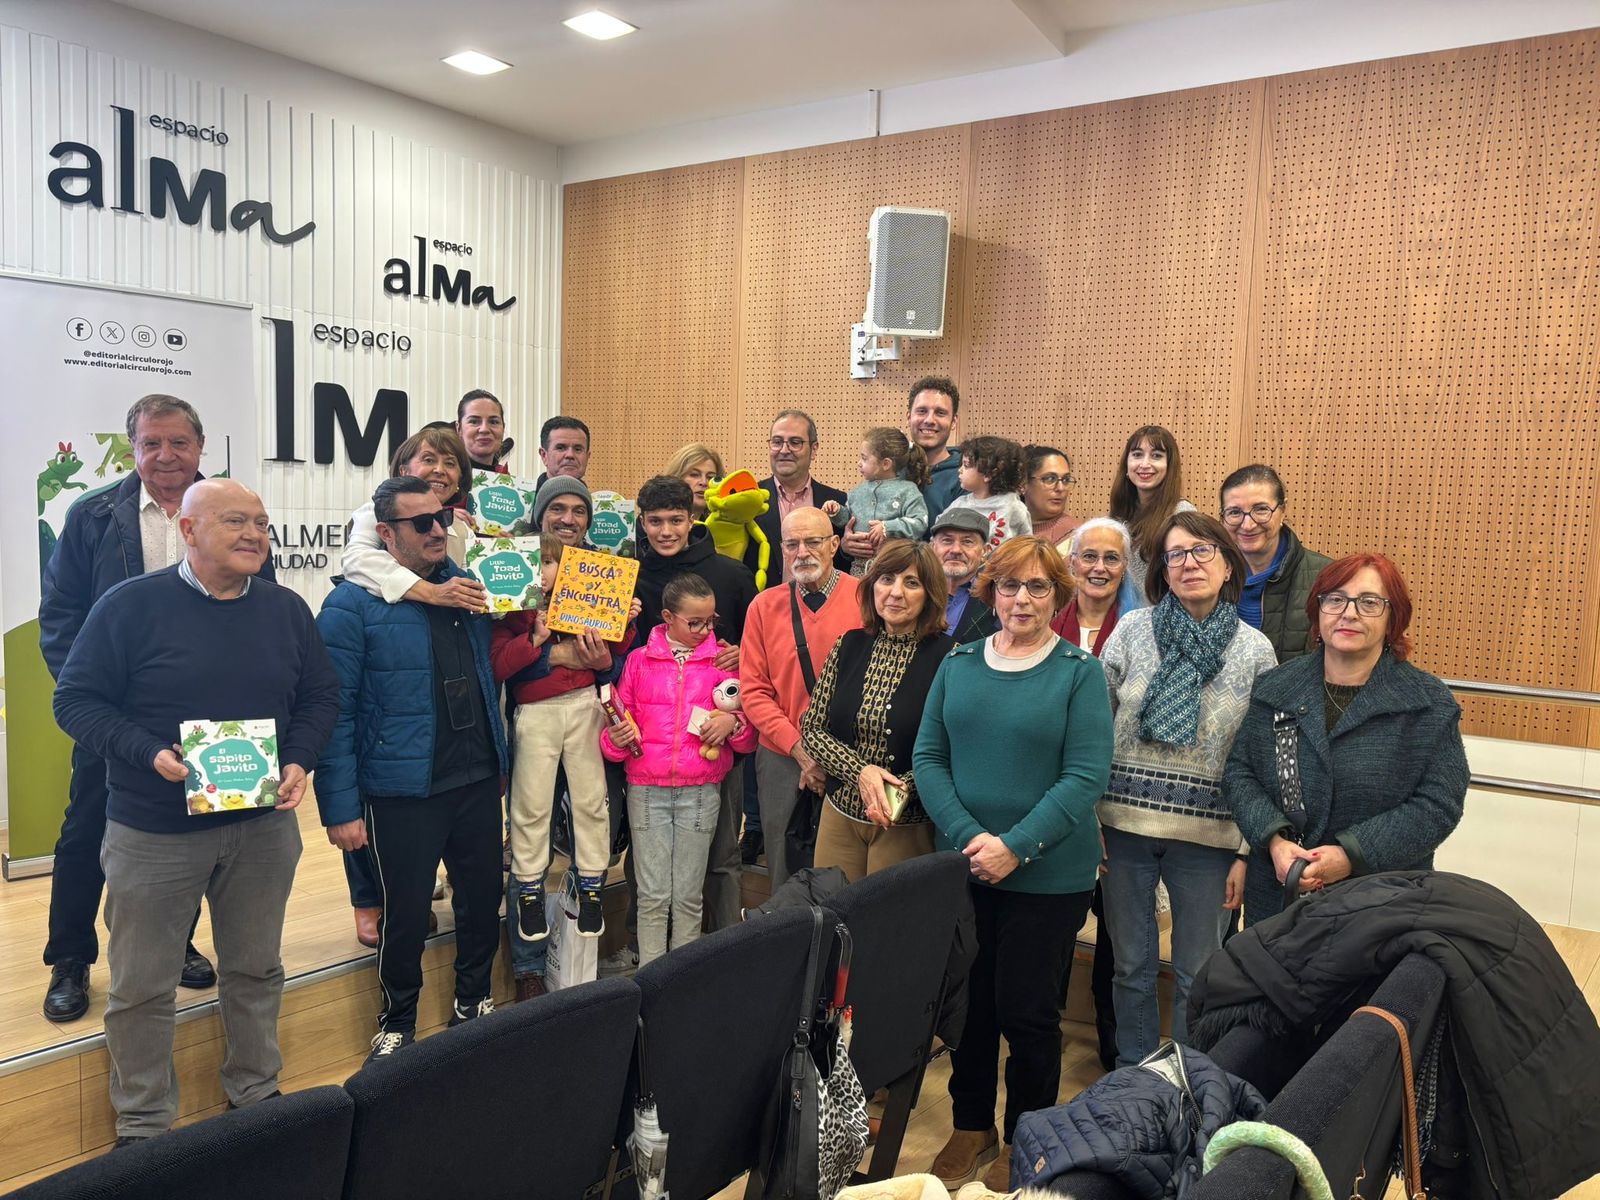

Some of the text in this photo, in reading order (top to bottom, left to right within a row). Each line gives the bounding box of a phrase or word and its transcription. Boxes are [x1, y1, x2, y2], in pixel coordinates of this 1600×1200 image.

[149, 113, 229, 146] espacio
[433, 239, 473, 256] espacio
[313, 323, 412, 352] espacio
[83, 350, 174, 366] @editorialcirculorojo
[63, 357, 192, 377] www.editorialcirculorojo.com
[485, 502, 517, 513] Javito
[491, 496, 516, 506] Toad
[272, 553, 328, 570] IUDAD
[493, 565, 521, 573] Toad
[489, 573, 525, 582] Javito
[579, 561, 615, 580] BUSCA
[560, 588, 621, 611] ENCUENTRA
[560, 612, 614, 630] DINOSAURIOS
[213, 763, 258, 775] Javito
